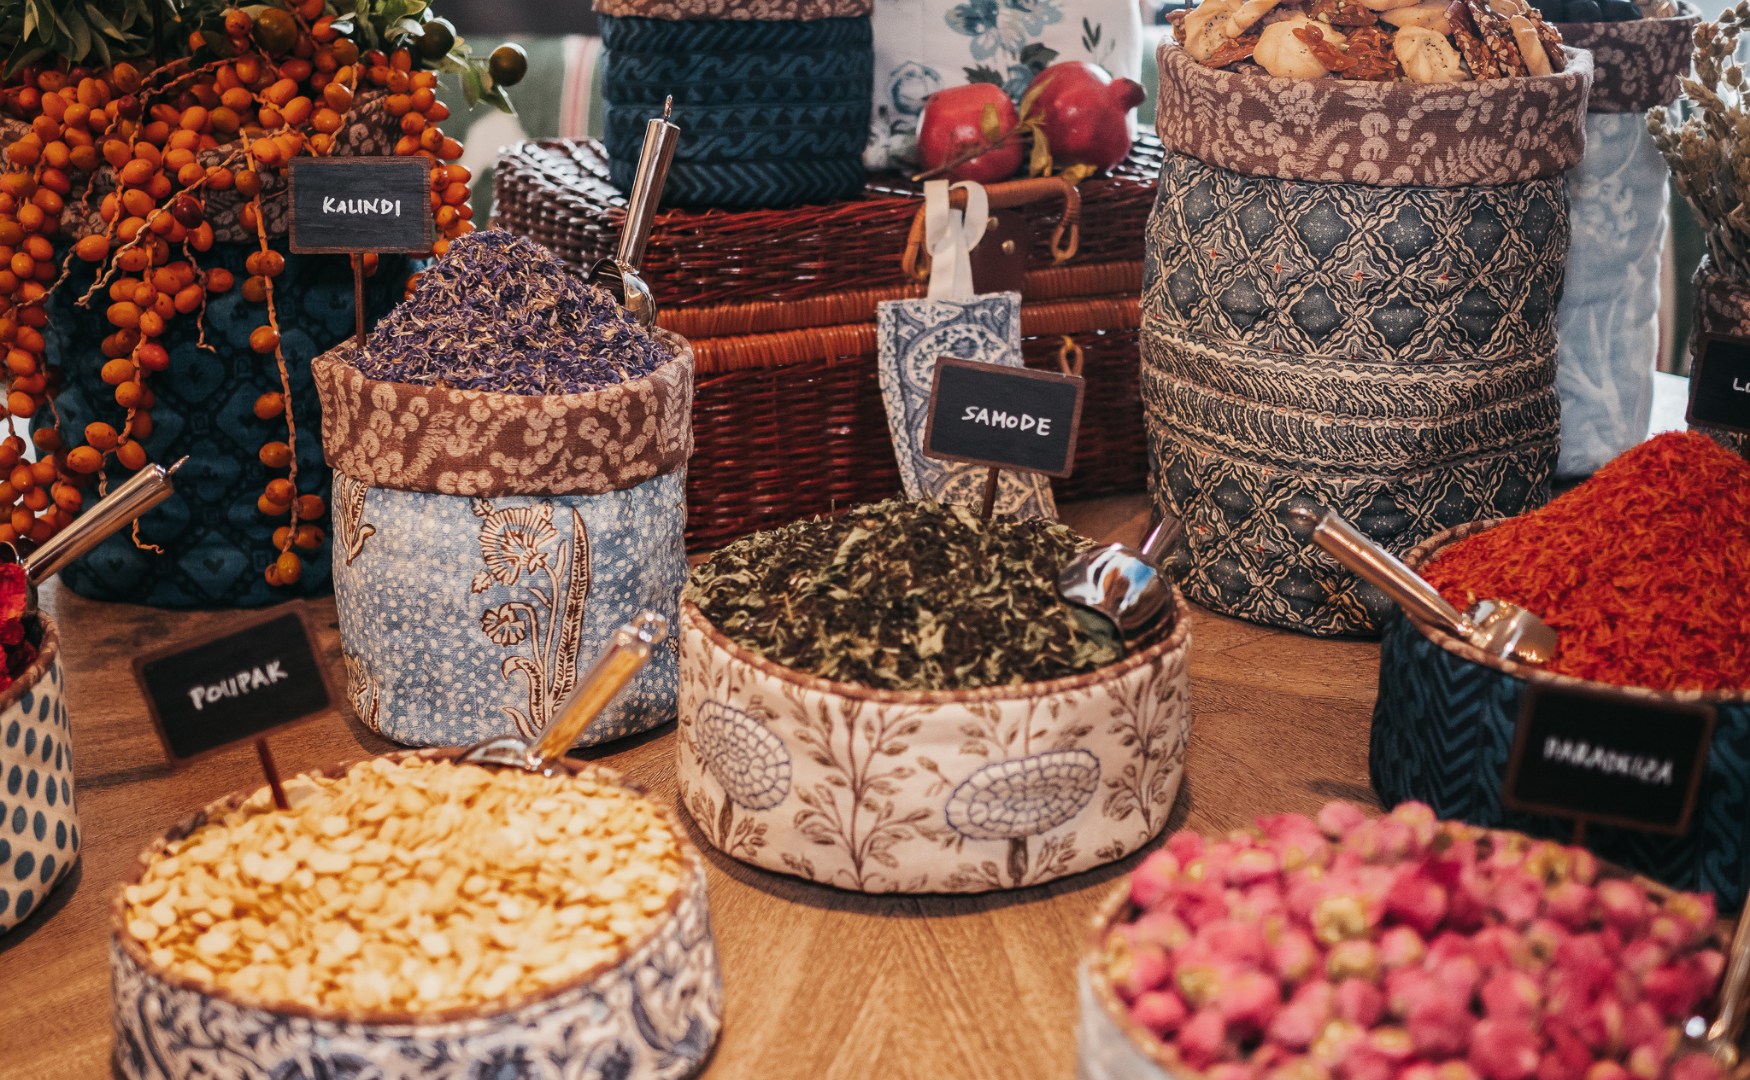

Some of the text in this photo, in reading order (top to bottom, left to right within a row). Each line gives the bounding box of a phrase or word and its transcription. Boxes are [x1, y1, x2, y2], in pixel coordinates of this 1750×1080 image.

[322, 196, 401, 217] KALINDI
[961, 406, 1051, 436] SAMODE
[188, 660, 288, 710] POUPAK
